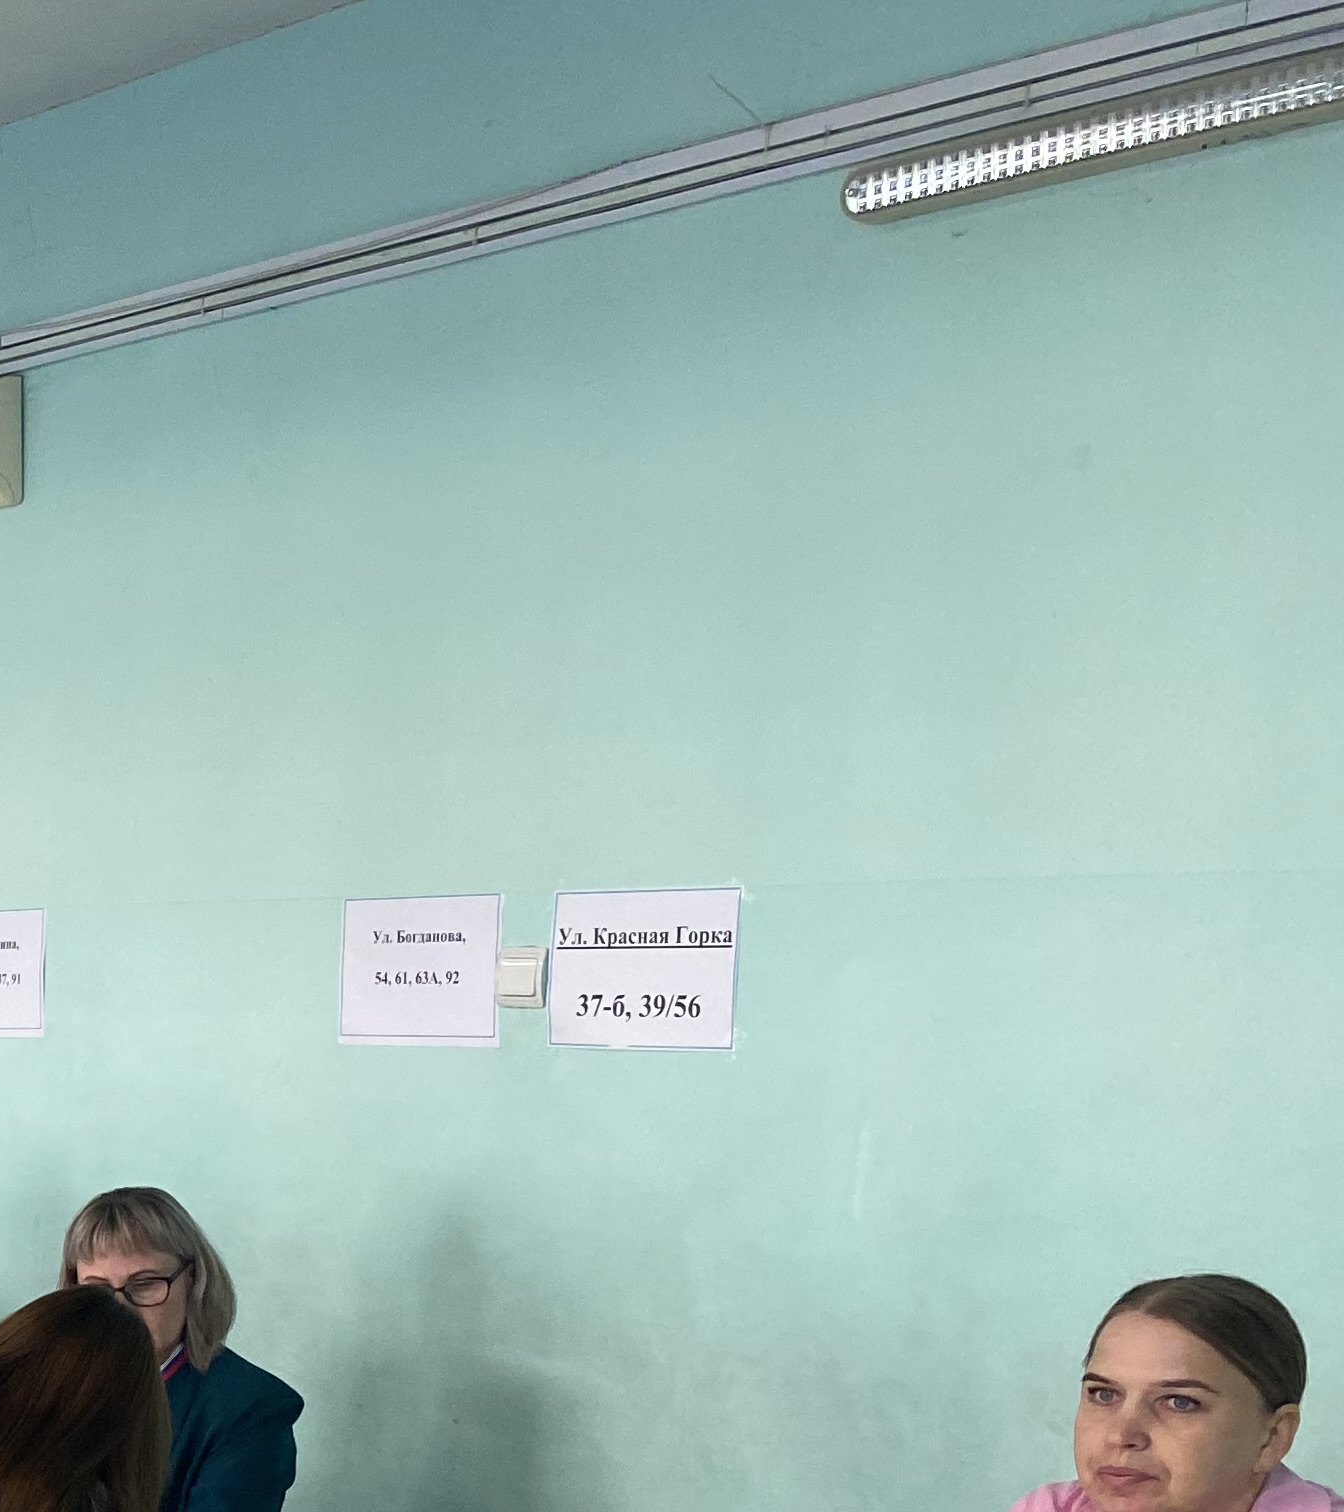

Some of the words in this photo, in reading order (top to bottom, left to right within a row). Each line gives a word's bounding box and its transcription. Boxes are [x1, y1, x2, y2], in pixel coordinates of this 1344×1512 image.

[373, 930, 393, 944] Ул.
[397, 930, 466, 944] Богданова,
[559, 928, 588, 946] Ул.
[593, 927, 669, 948] Красная
[676, 926, 733, 947] Горка
[11, 974, 21, 985] 91
[374, 972, 392, 987] 54,
[395, 972, 412, 987] 61,
[415, 971, 443, 987] 63А,
[446, 971, 460, 985] 92
[638, 994, 702, 1018] 39/56
